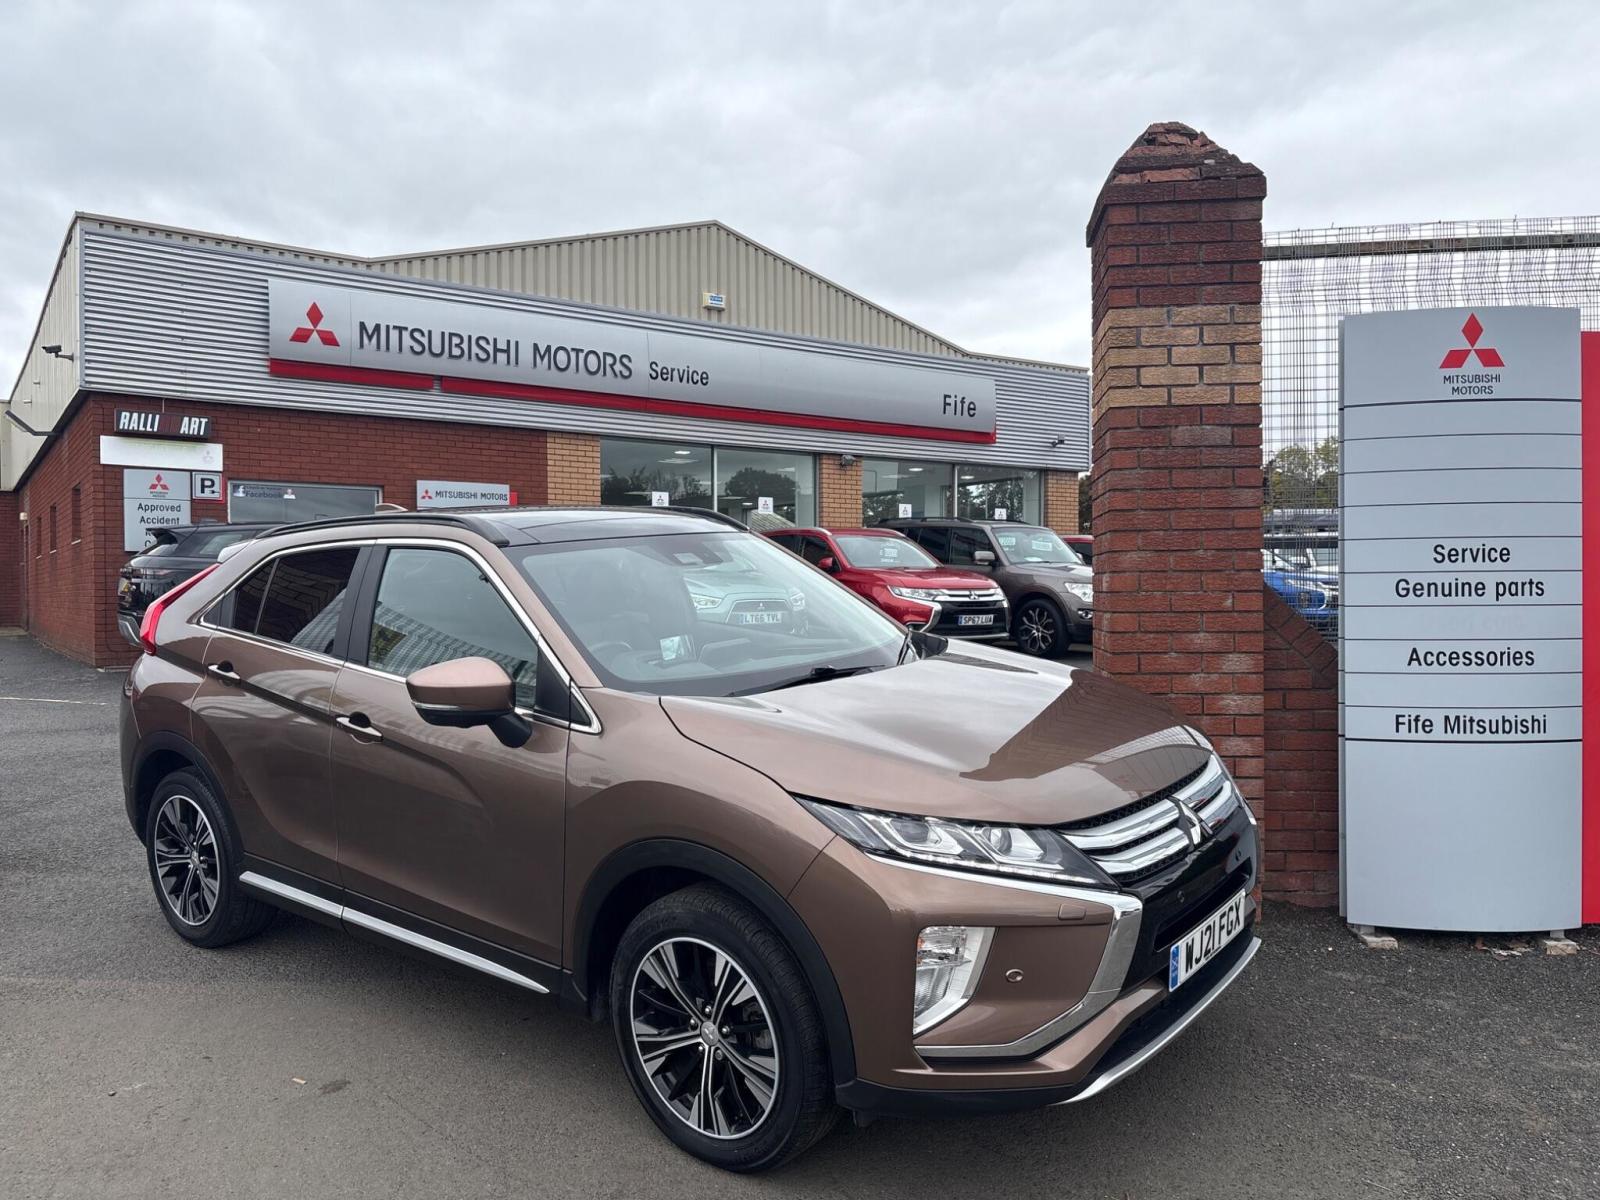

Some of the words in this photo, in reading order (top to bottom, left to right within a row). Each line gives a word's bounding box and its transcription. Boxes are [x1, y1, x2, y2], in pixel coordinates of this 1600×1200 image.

[358, 321, 519, 367] MITSUBISHI
[533, 342, 632, 379] MOTORS
[649, 361, 709, 386] Service
[1443, 373, 1501, 384] MITSUBISHI
[1451, 385, 1494, 395] MOTORS
[943, 394, 976, 417] Fife
[119, 411, 160, 432] RALLI
[180, 416, 208, 435] ART
[200, 478, 215, 494] P
[435, 490, 478, 499] MITSUBISHI
[480, 492, 508, 501] MOTORS
[137, 503, 181, 512] Approved
[139, 516, 180, 525] Accident
[1433, 544, 1511, 563] Service
[1395, 578, 1486, 597] Genuine
[1495, 578, 1545, 601] parts
[1407, 647, 1535, 666] Accessories
[1395, 714, 1433, 733] Fife
[1444, 714, 1547, 734] Mitsubishi
[1185, 919, 1216, 974] WJ21
[1218, 897, 1241, 945] FGX
